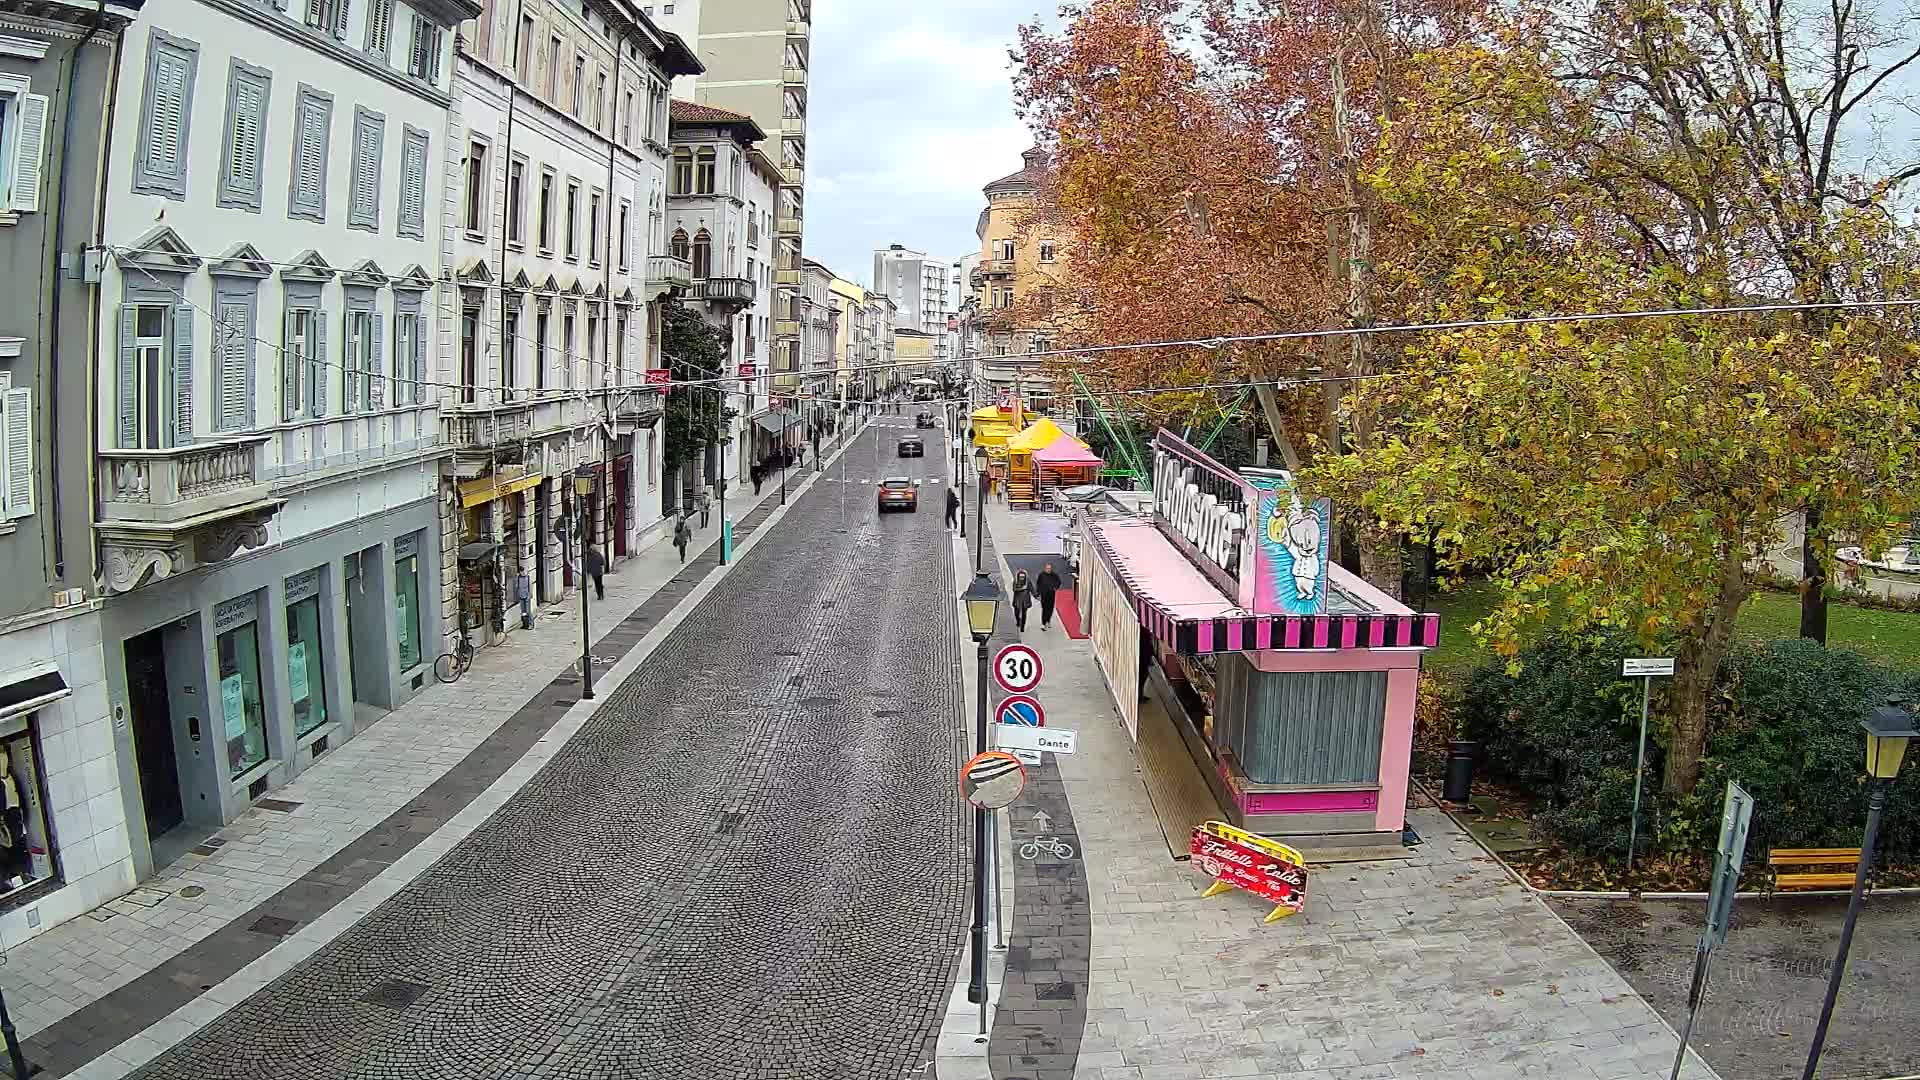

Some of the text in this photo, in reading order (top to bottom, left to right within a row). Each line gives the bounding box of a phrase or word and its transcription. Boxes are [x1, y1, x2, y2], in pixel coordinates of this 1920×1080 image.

[1162, 458, 1241, 569] Golosone
[1005, 658, 1032, 680] 30
[1038, 737, 1069, 749] Dante
